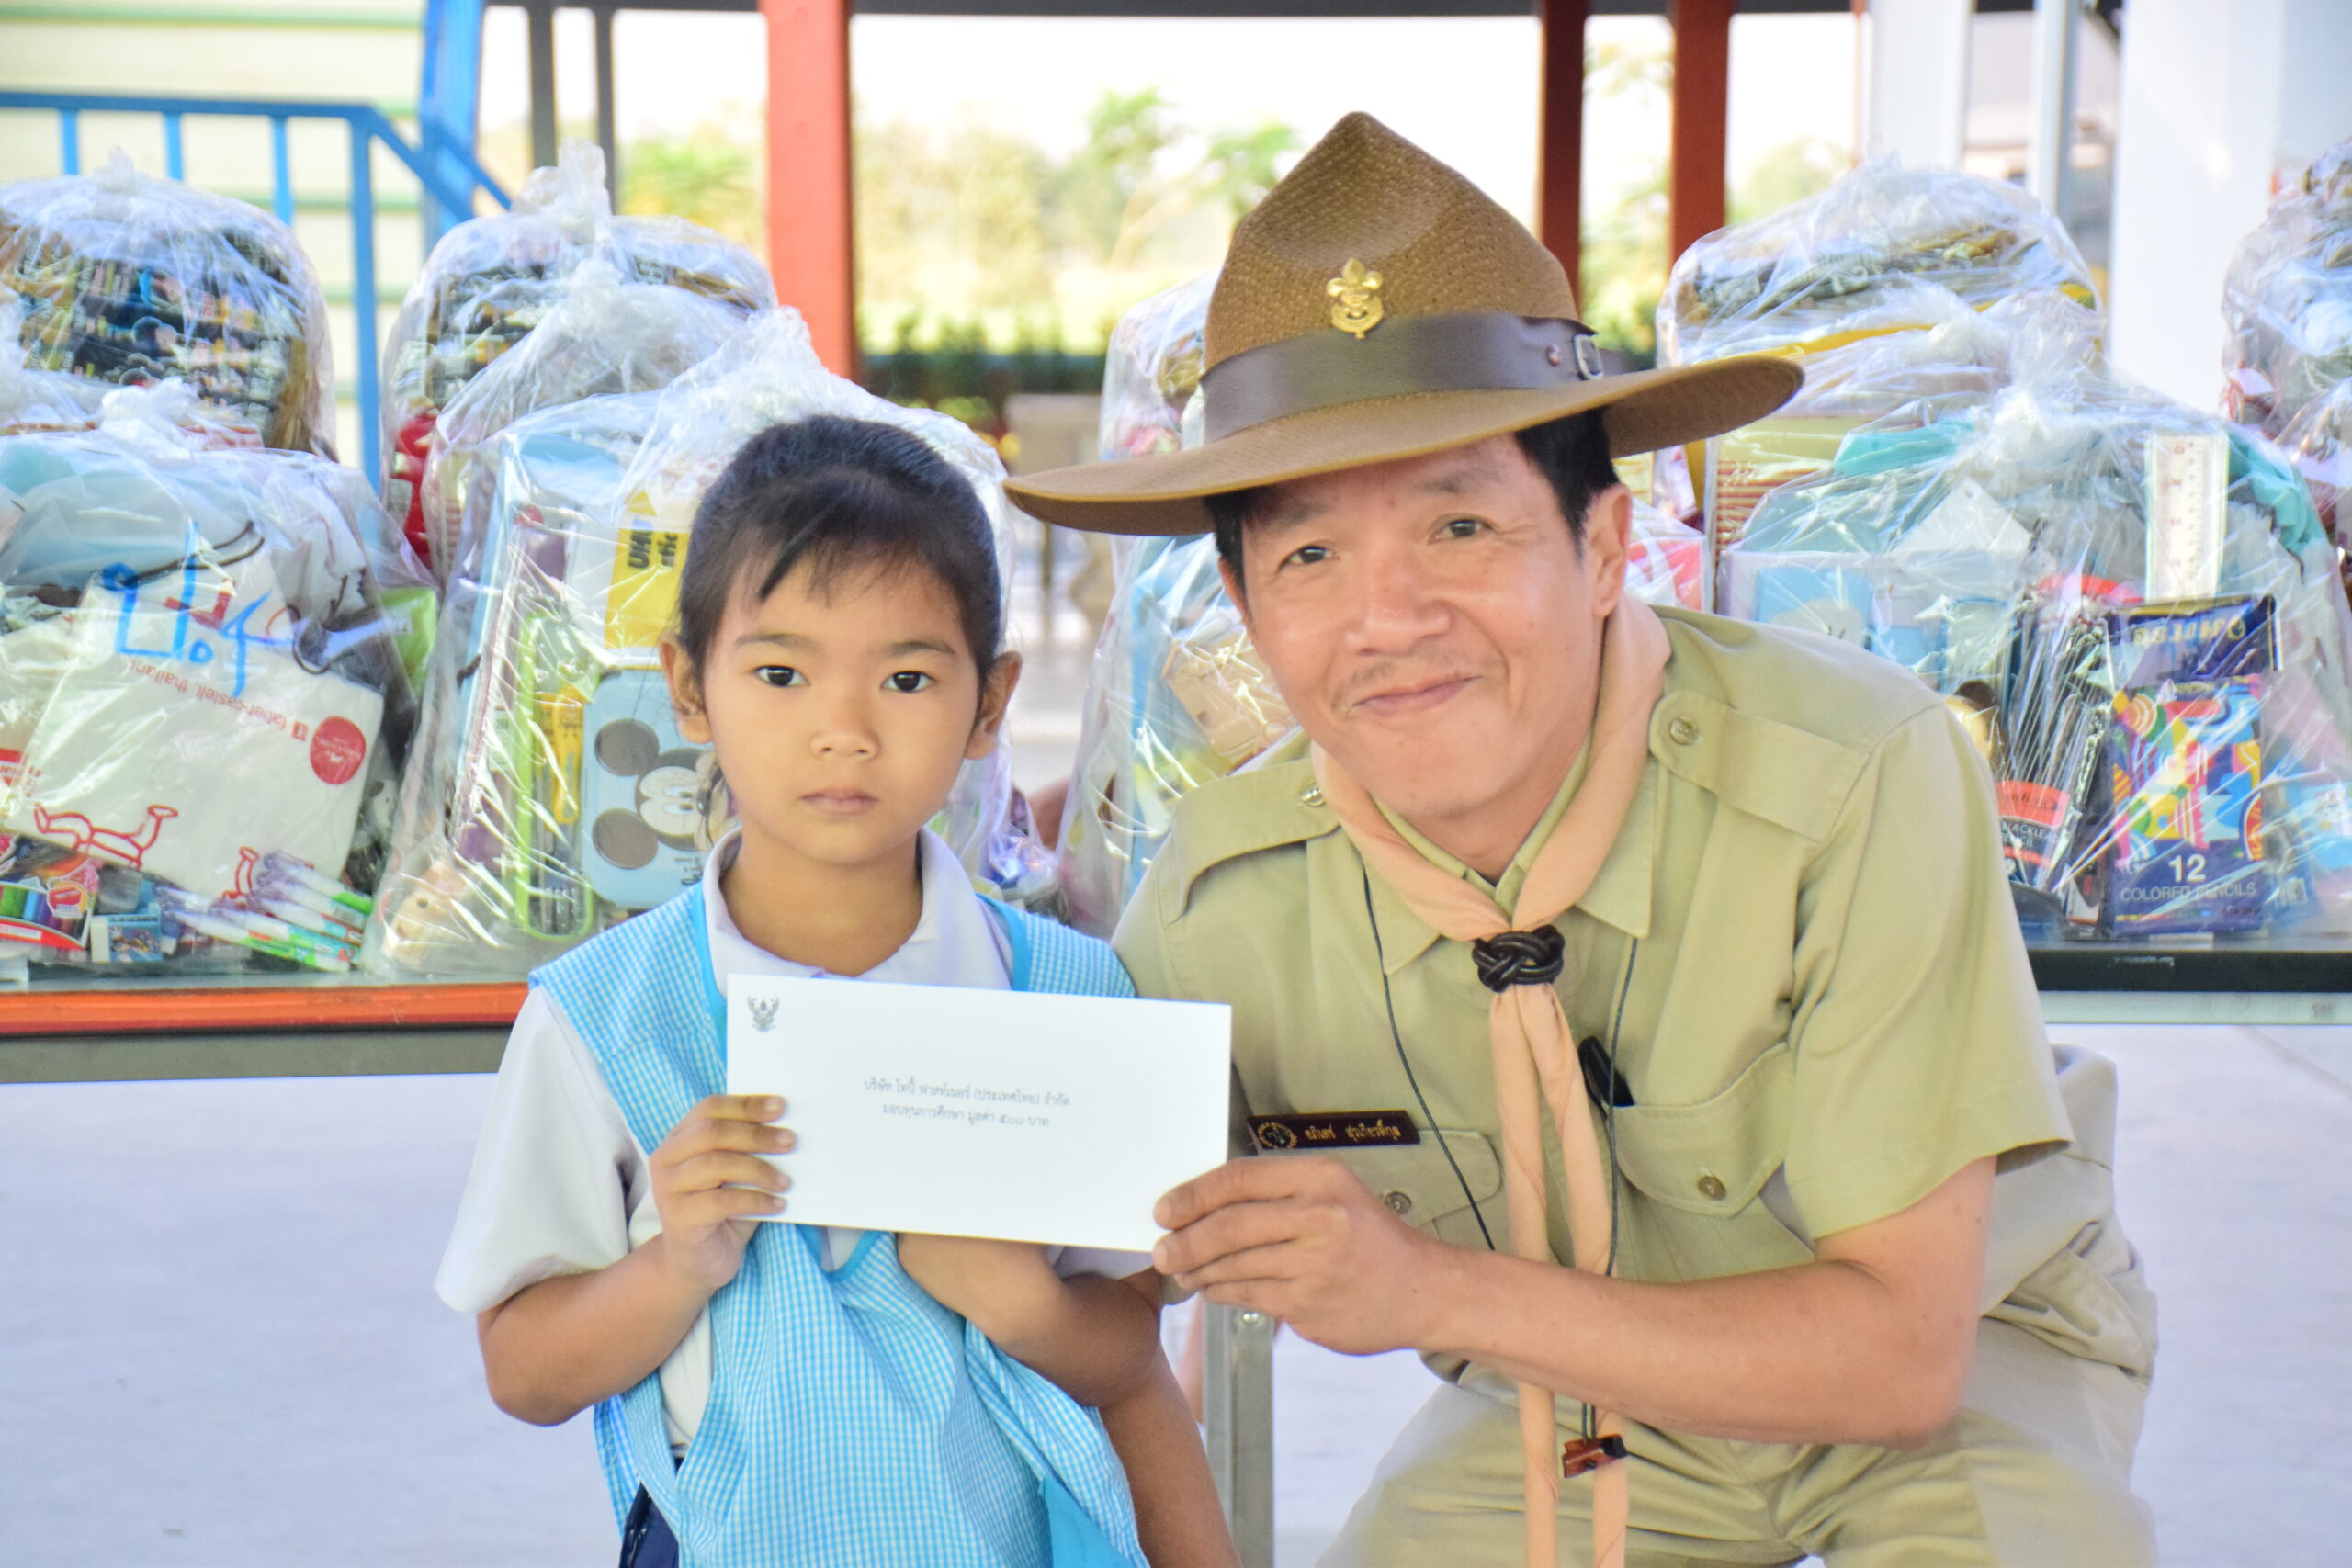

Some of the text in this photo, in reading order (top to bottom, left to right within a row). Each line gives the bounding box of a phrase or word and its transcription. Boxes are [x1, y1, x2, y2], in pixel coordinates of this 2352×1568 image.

[2168, 853, 2207, 883] 12
[2120, 886, 2191, 902] COLORED
[864, 1077, 893, 1091] บริษัท
[1044, 1091, 1069, 1106] จำกัด
[1027, 1116, 1049, 1127] บาท
